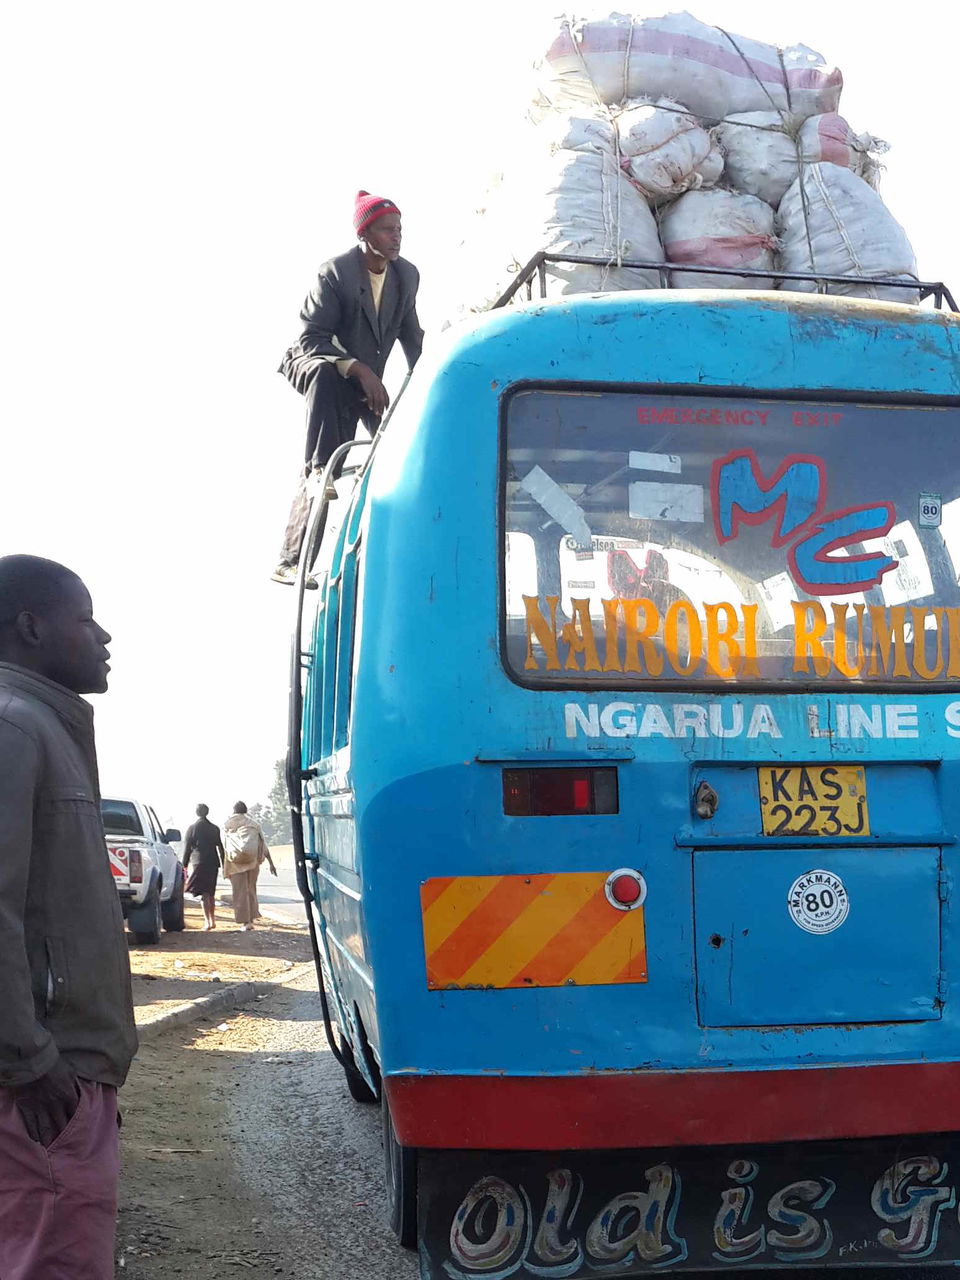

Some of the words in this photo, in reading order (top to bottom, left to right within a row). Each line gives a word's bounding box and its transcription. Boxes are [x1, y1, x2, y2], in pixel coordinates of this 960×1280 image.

[636, 407, 771, 426] EMERGENCY
[791, 411, 844, 427] EXIT
[922, 505, 938, 516] 80
[522, 595, 760, 678] NAIROBI
[564, 703, 785, 740] NGARUA
[807, 704, 920, 739] LINE
[770, 768, 843, 802] KAS
[770, 802, 865, 836] 223J
[792, 874, 845, 908] MARKMANN
[805, 889, 834, 912] 80
[713, 1159, 834, 1260] is
